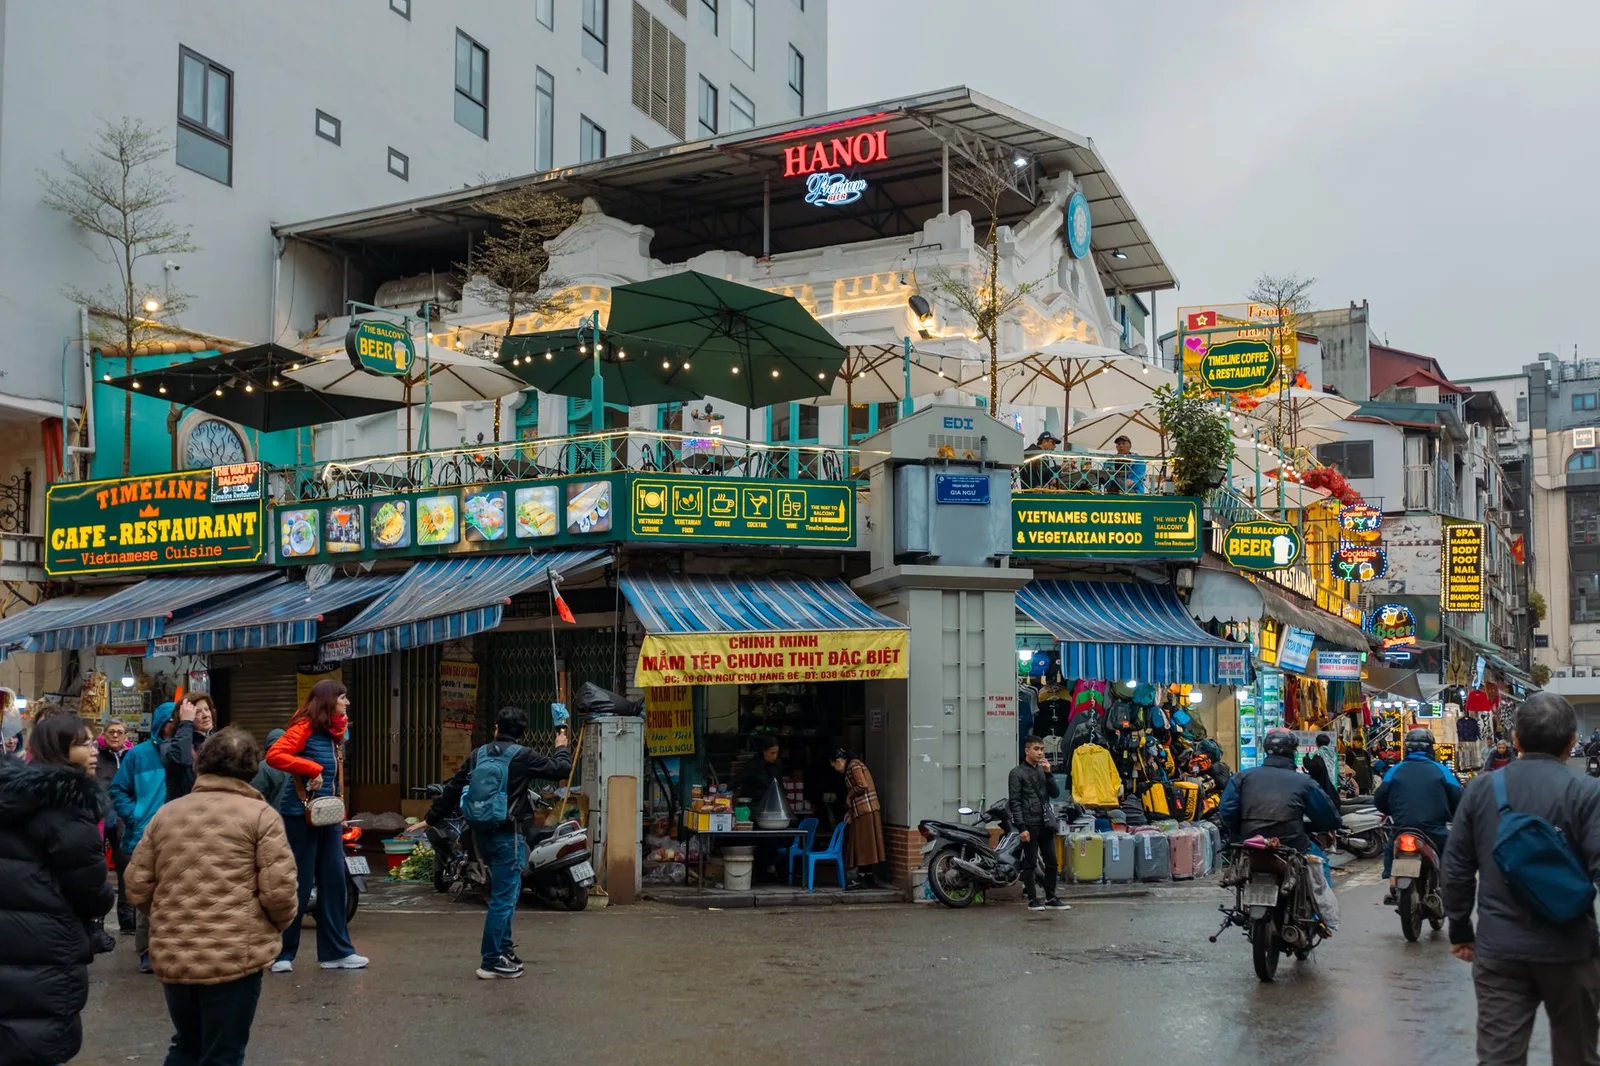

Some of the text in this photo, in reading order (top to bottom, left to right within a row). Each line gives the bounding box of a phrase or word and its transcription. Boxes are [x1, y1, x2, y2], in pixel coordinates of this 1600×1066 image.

[784, 130, 888, 177] HANOI
[805, 172, 868, 206] Premium
[827, 193, 847, 202] BEER
[363, 325, 406, 340] THE BALCONY
[360, 337, 393, 361] BEER
[1208, 351, 1269, 366] TIMELINE COFFEE
[1208, 365, 1267, 380] & RESTAURANT
[943, 416, 974, 430] EDI
[214, 463, 259, 477] THE WAY TO
[218, 474, 254, 487] BALCONY
[97, 480, 209, 509] TIMELINE
[1018, 510, 1142, 524] VIETNAMES CUISINE
[119, 512, 258, 545] RESTAURANT
[747, 521, 768, 529] COCKTAIL
[1236, 526, 1290, 535] THE BALCONY
[1016, 531, 1143, 544] & VEGETARIAN FOOD
[1455, 529, 1475, 537] SPA
[1229, 538, 1271, 557] BEER
[1341, 550, 1377, 558] Cocktails
[1452, 546, 1478, 554] BODY
[81, 544, 223, 566] Vietnamese Cuisine
[1453, 556, 1477, 564] FOOT
[1454, 566, 1476, 574] NAIL
[1373, 623, 1415, 638] Beer
[779, 636, 818, 648] MINH
[642, 647, 900, 671] MẮM TÉP CHƯNG THỊT ĐẶC BIỆT
[313, 663, 334, 672] MENU
[664, 675, 679, 684] ĐC:
[683, 674, 694, 683] 49
[696, 674, 712, 683] GIA
[738, 673, 757, 682] CHỢ
[821, 671, 837, 679] 038
[860, 669, 881, 678] 7107
[660, 745, 673, 753] GIA
